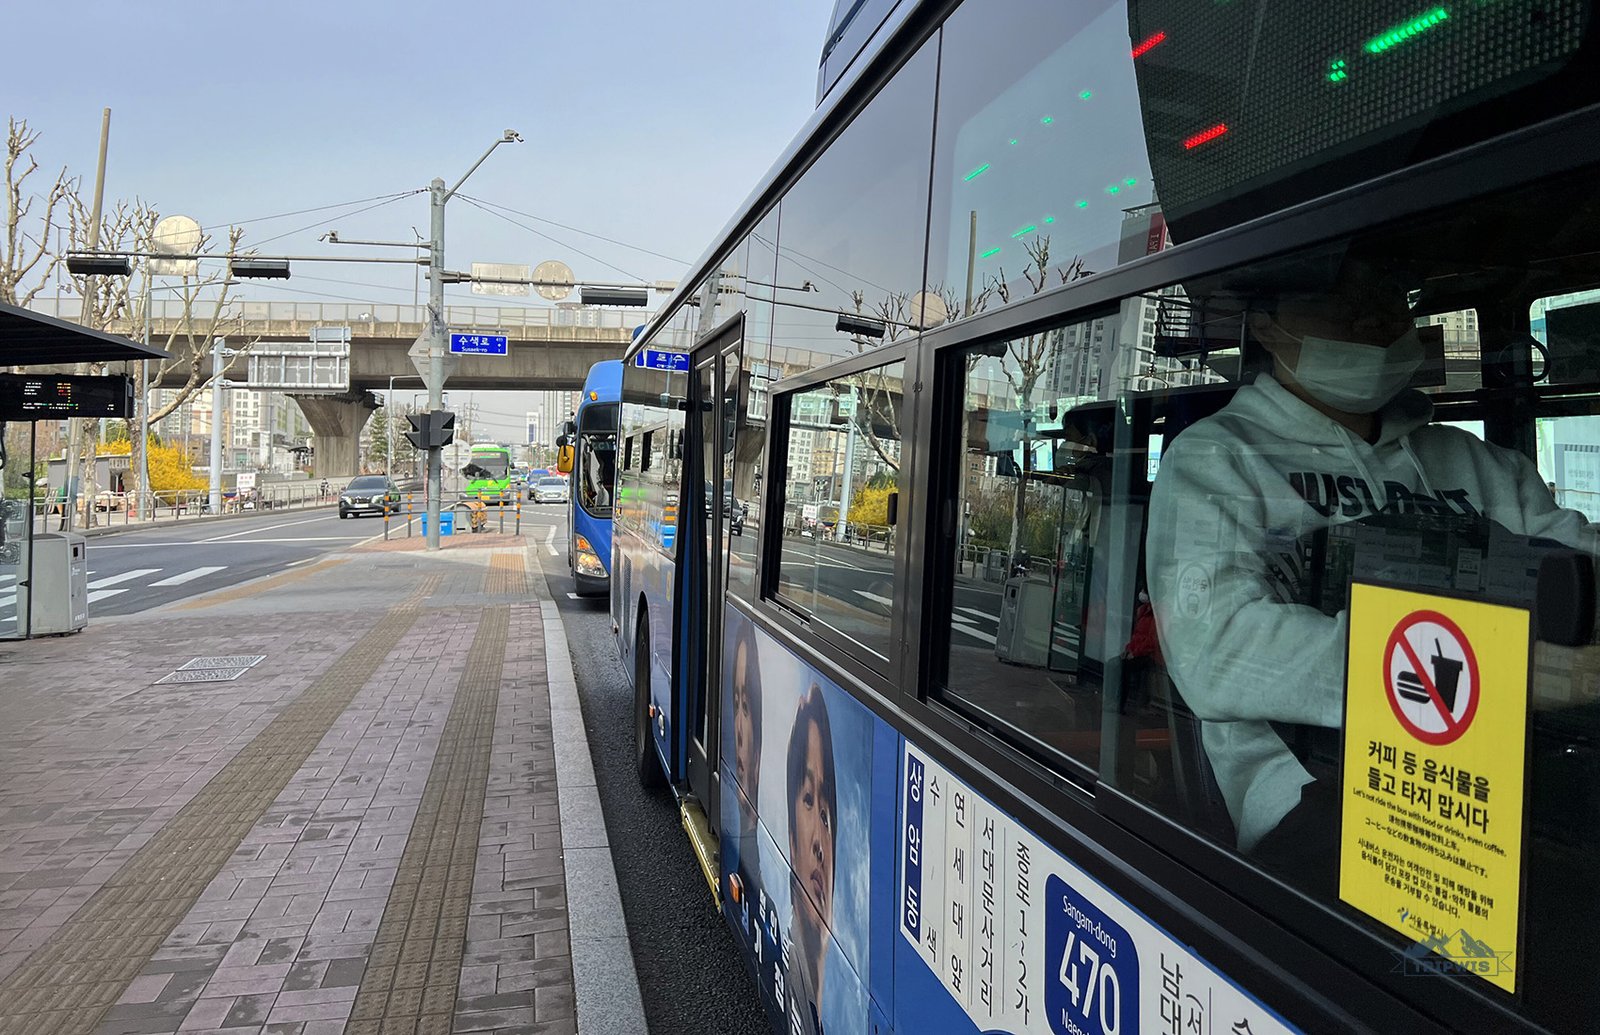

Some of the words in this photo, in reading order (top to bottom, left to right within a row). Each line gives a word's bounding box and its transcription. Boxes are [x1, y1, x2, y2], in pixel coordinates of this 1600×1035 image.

[458, 336, 490, 347] 수색로
[1367, 766, 1397, 796] 들고
[1401, 780, 1432, 812] 타지
[1438, 793, 1490, 834] 맙시다
[1368, 740, 1397, 769] 커피
[1402, 751, 1417, 776] 등
[1422, 758, 1491, 804] 음식물을
[907, 762, 922, 929] 상암동
[1353, 787, 1366, 799] Let's
[1386, 801, 1396, 811] the
[1397, 805, 1407, 815] bus
[1408, 810, 1422, 822] with
[1422, 814, 1436, 828] food
[1467, 835, 1484, 848] even
[951, 791, 965, 994] 연세대앞
[980, 816, 995, 1018] 서대문사거리
[1062, 895, 1117, 959] Sangam-dong
[1059, 930, 1120, 1035] 470
[1160, 952, 1183, 1035] 남대
